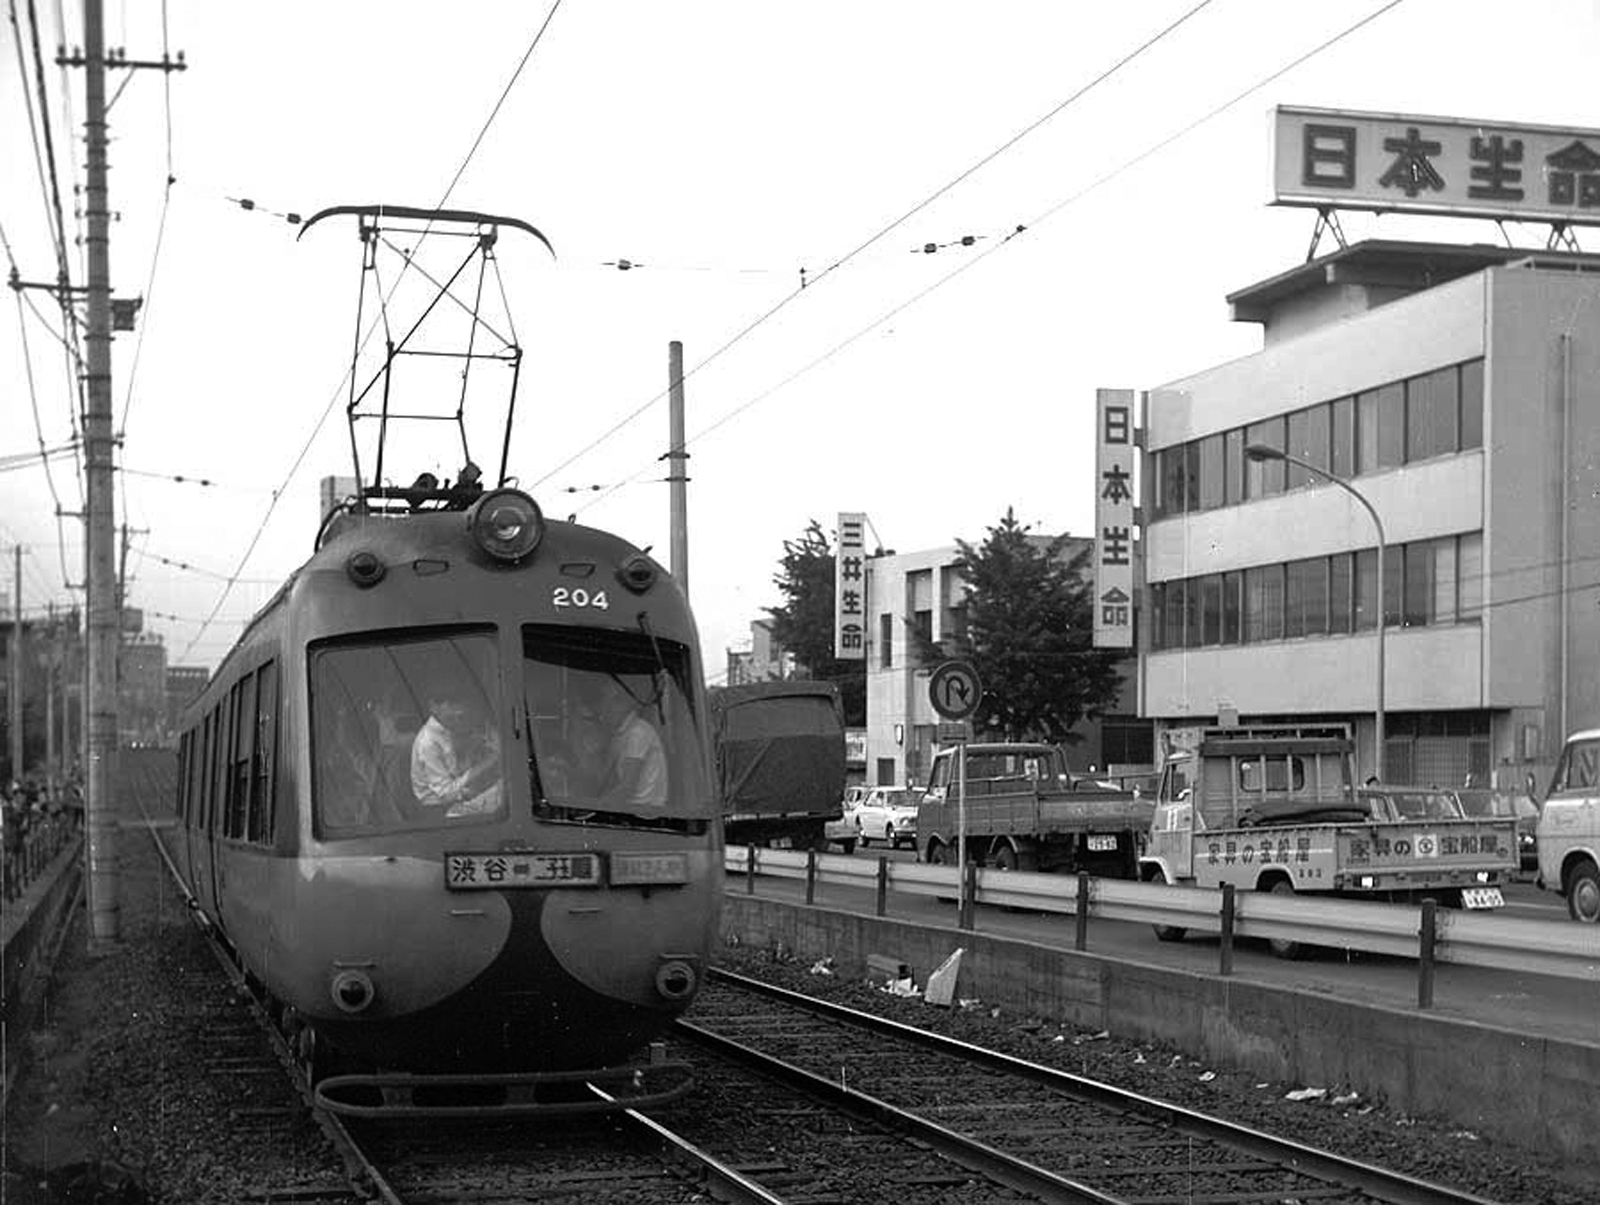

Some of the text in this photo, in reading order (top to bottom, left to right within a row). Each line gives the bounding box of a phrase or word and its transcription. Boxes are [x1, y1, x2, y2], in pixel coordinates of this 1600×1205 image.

[1302, 123, 1600, 208] 日本生命
[1101, 406, 1130, 626] 日本生命
[553, 587, 609, 610] 204
[842, 522, 862, 649] 三井生命
